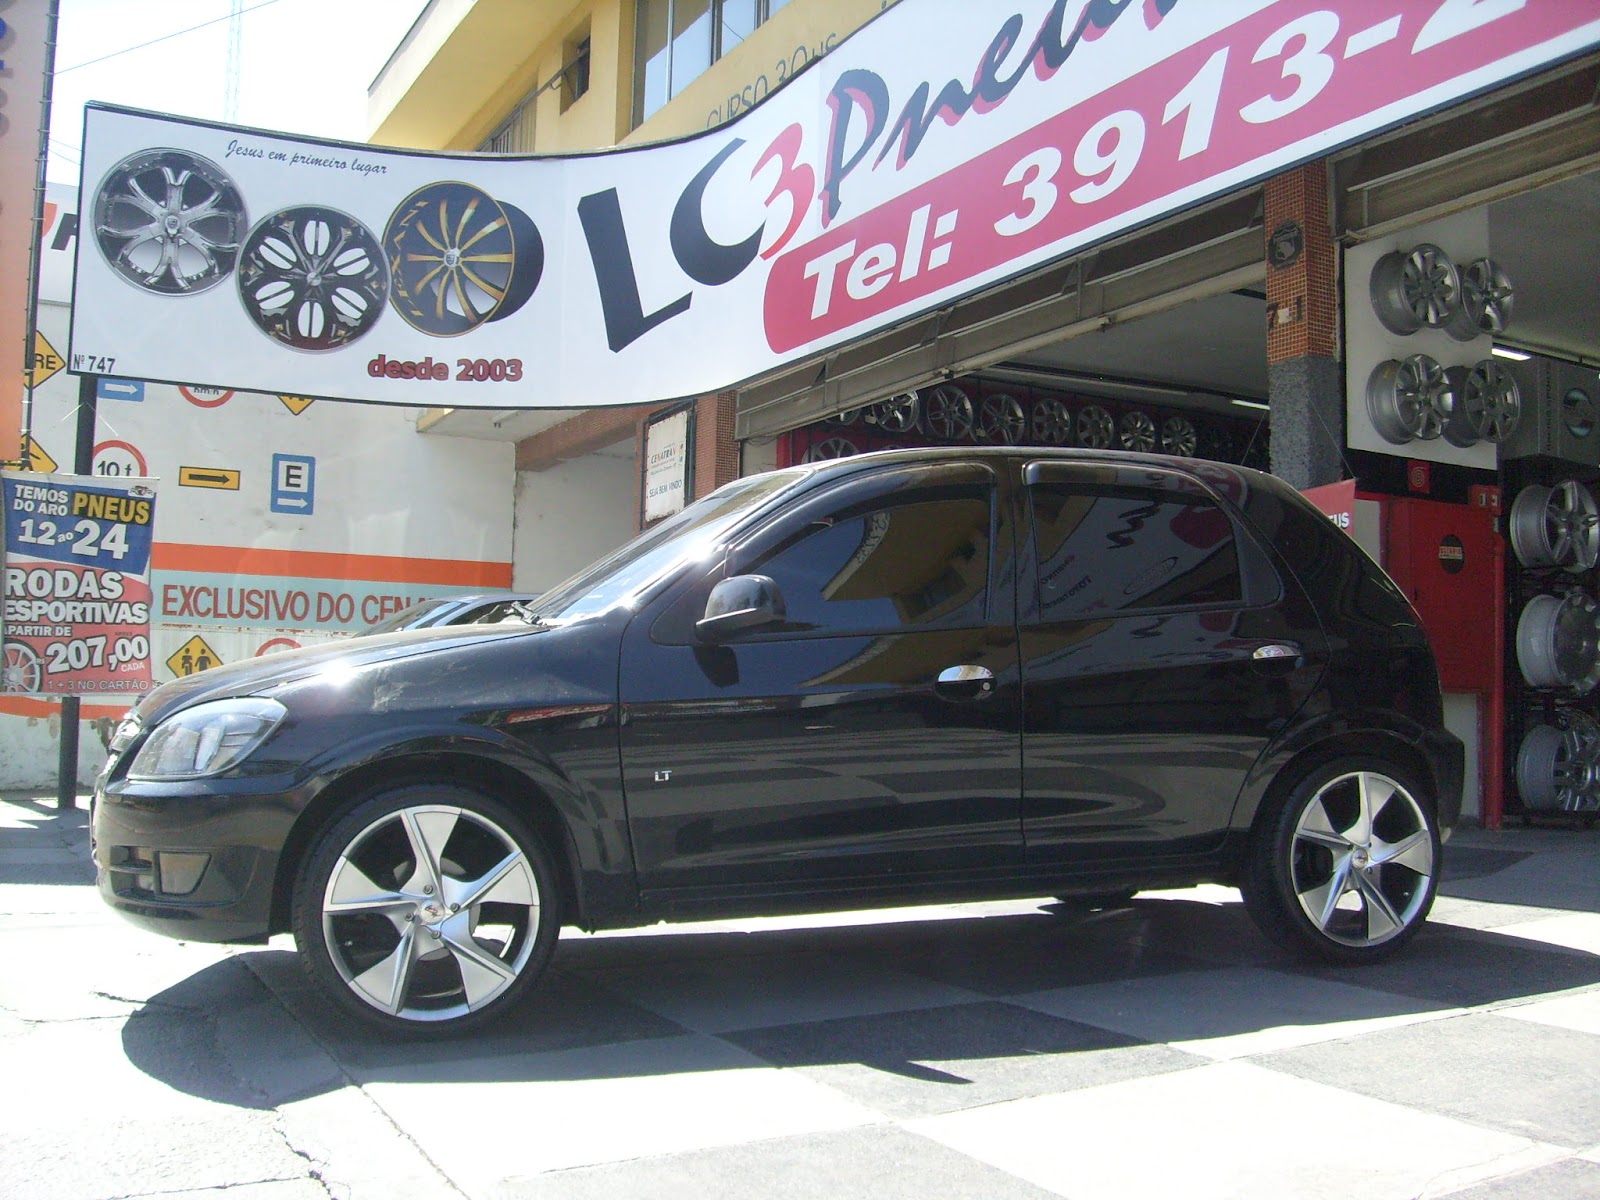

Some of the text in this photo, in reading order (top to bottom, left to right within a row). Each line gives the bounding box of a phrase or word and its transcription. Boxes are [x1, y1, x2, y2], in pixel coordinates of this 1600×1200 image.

[816, 0, 1179, 231] Pneu
[225, 139, 388, 177] Jesus em primeiro lugar
[803, 203, 959, 320] Tel:
[88, 355, 116, 374] 747
[367, 353, 523, 383] desde 2003
[285, 464, 303, 488] E
[14, 484, 69, 504] TEMOS
[13, 498, 69, 517] DO ARO
[71, 491, 150, 525] PNEUS
[18, 518, 130, 561] 12 ao 24
[5, 568, 125, 600] RODAS
[5, 600, 149, 625] ESPORTIVAS
[161, 584, 310, 622] EXCLUSIVO
[316, 591, 356, 624] DO
[55, 626, 72, 637] DE
[120, 661, 146, 673] CADA
[67, 680, 74, 690] 3
[77, 680, 96, 690] NO
[99, 678, 149, 690] CARTÃO
[654, 770, 672, 782] LT
